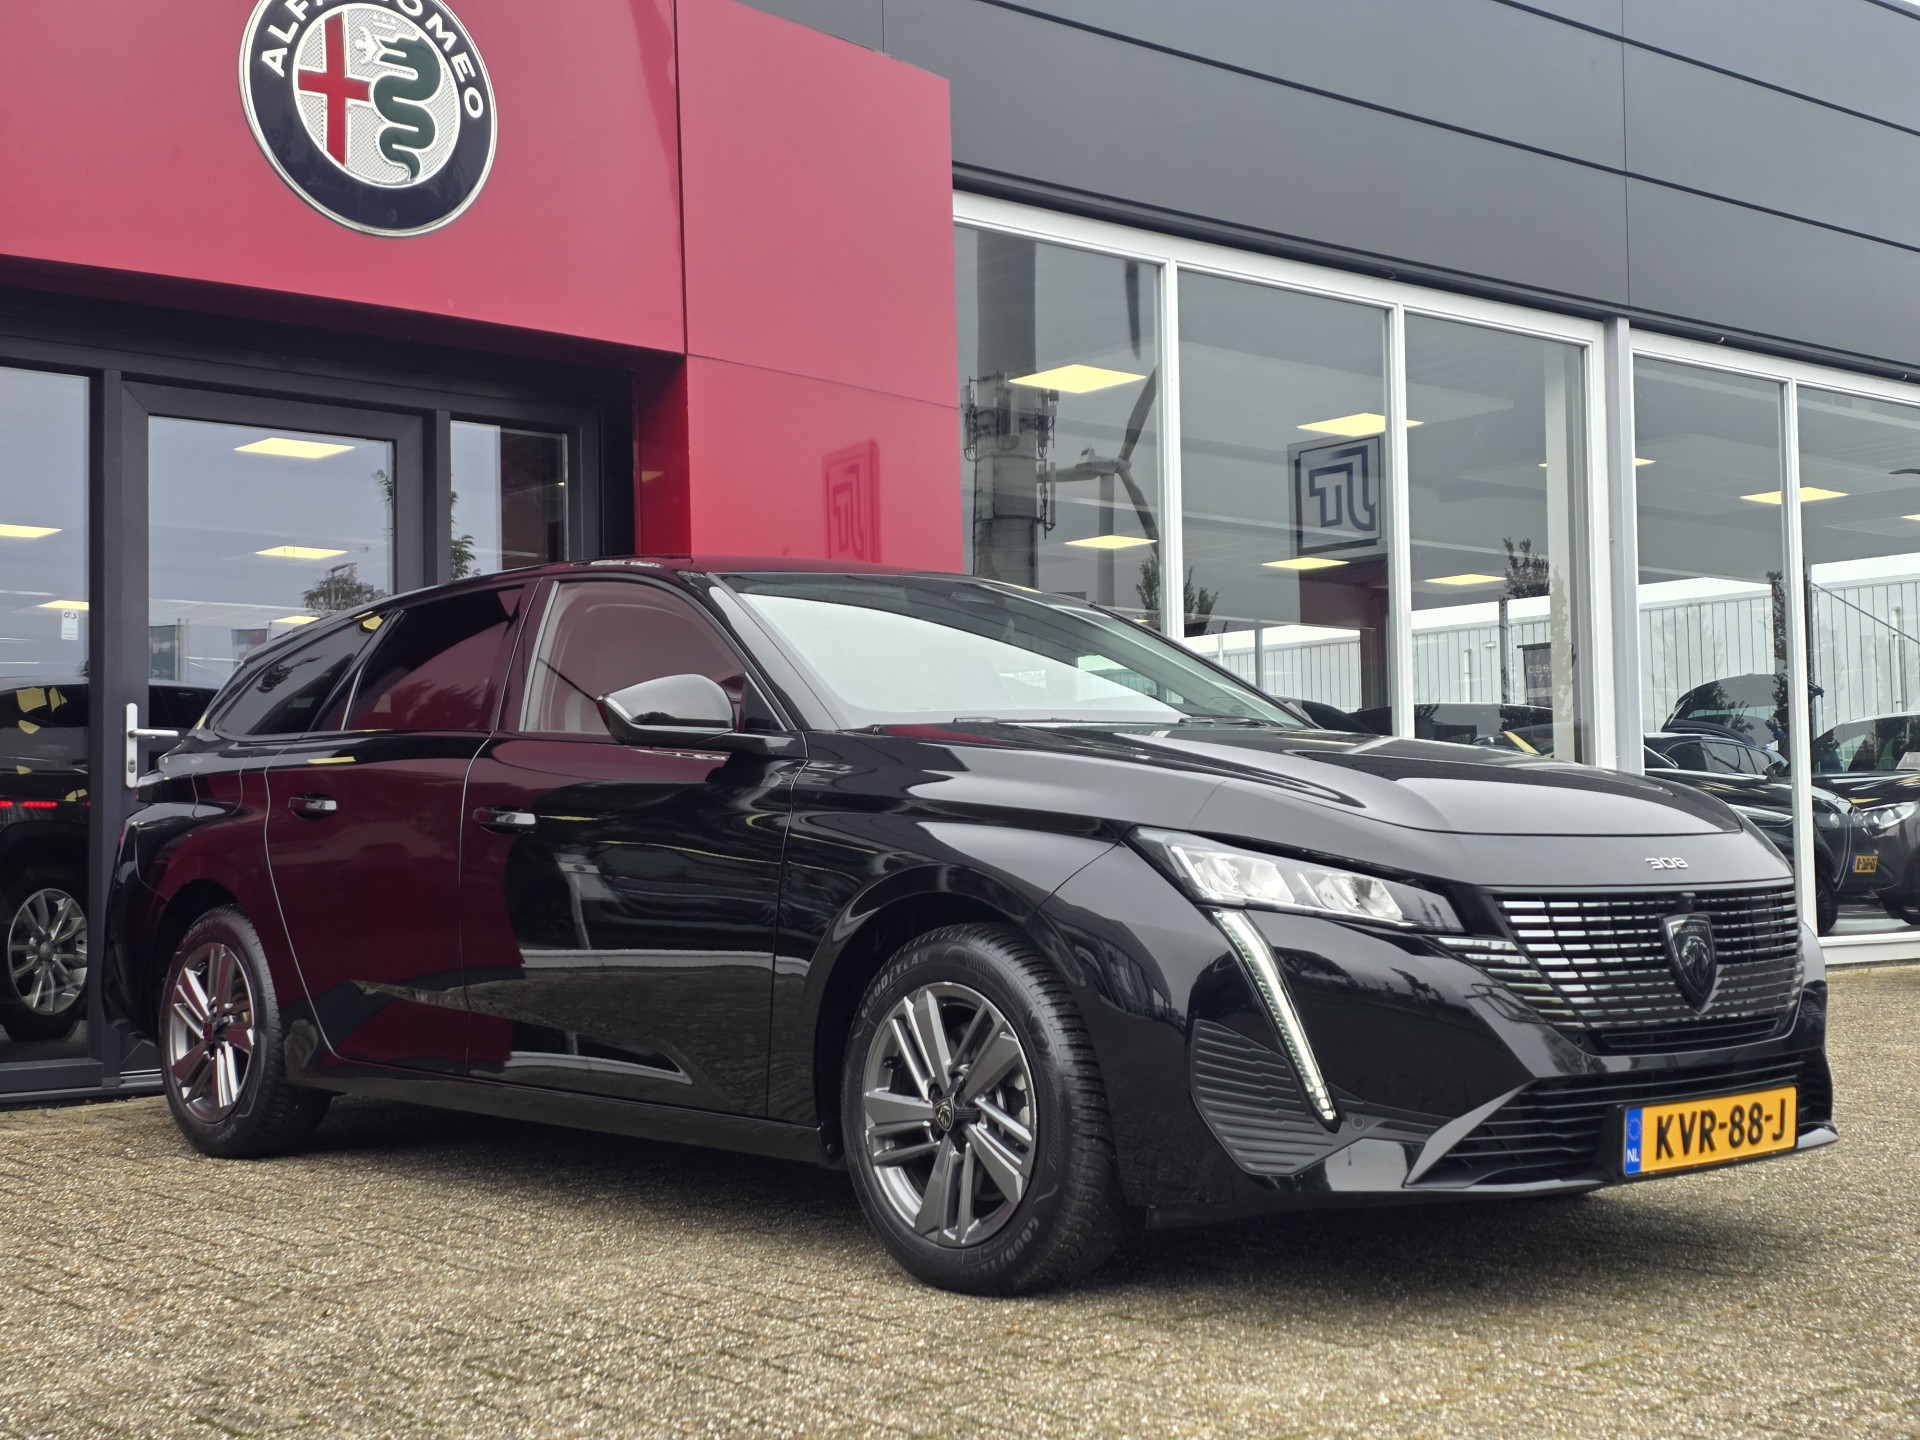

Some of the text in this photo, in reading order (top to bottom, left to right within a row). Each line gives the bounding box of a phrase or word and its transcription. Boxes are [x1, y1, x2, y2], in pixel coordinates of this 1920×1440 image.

[261, 0, 484, 118] ALF OMEO
[1645, 857, 1689, 870] 308
[1656, 1098, 1786, 1160] KVR-88-J
[1627, 1148, 1640, 1163] NL
